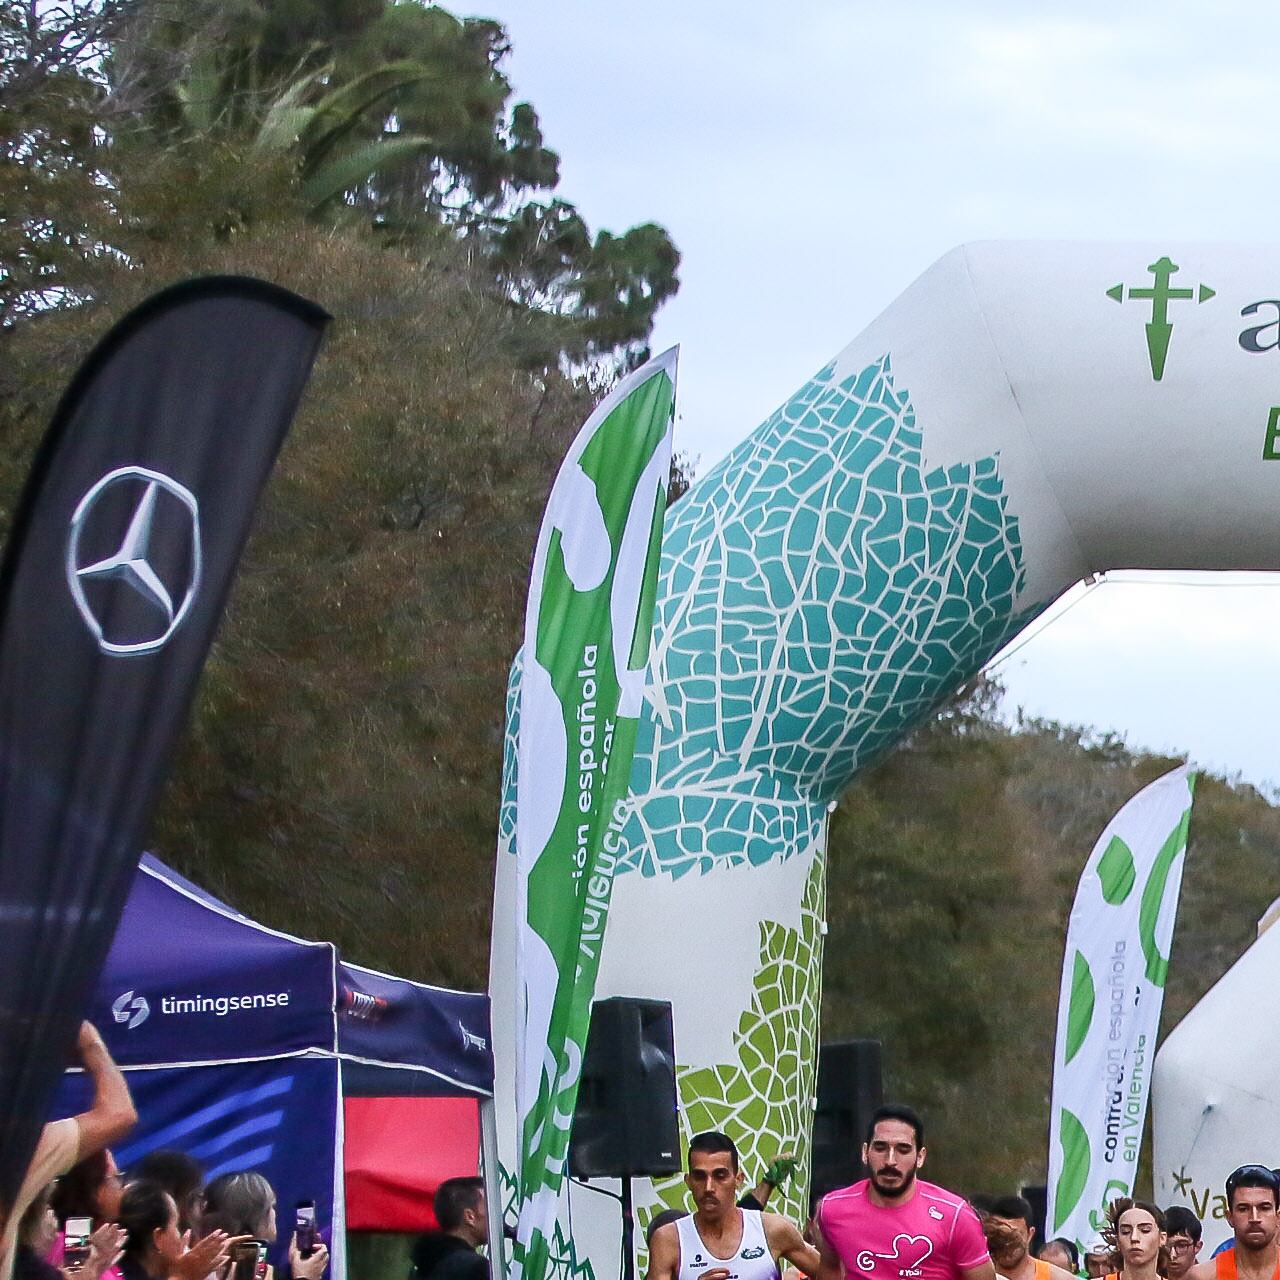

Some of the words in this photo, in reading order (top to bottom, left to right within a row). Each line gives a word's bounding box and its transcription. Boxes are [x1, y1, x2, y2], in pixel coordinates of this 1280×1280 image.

[576, 644, 598, 814] española
[161, 992, 289, 1016] timingsense
[1121, 1034, 1147, 1130] Valencia
[1122, 1135, 1138, 1163] en
